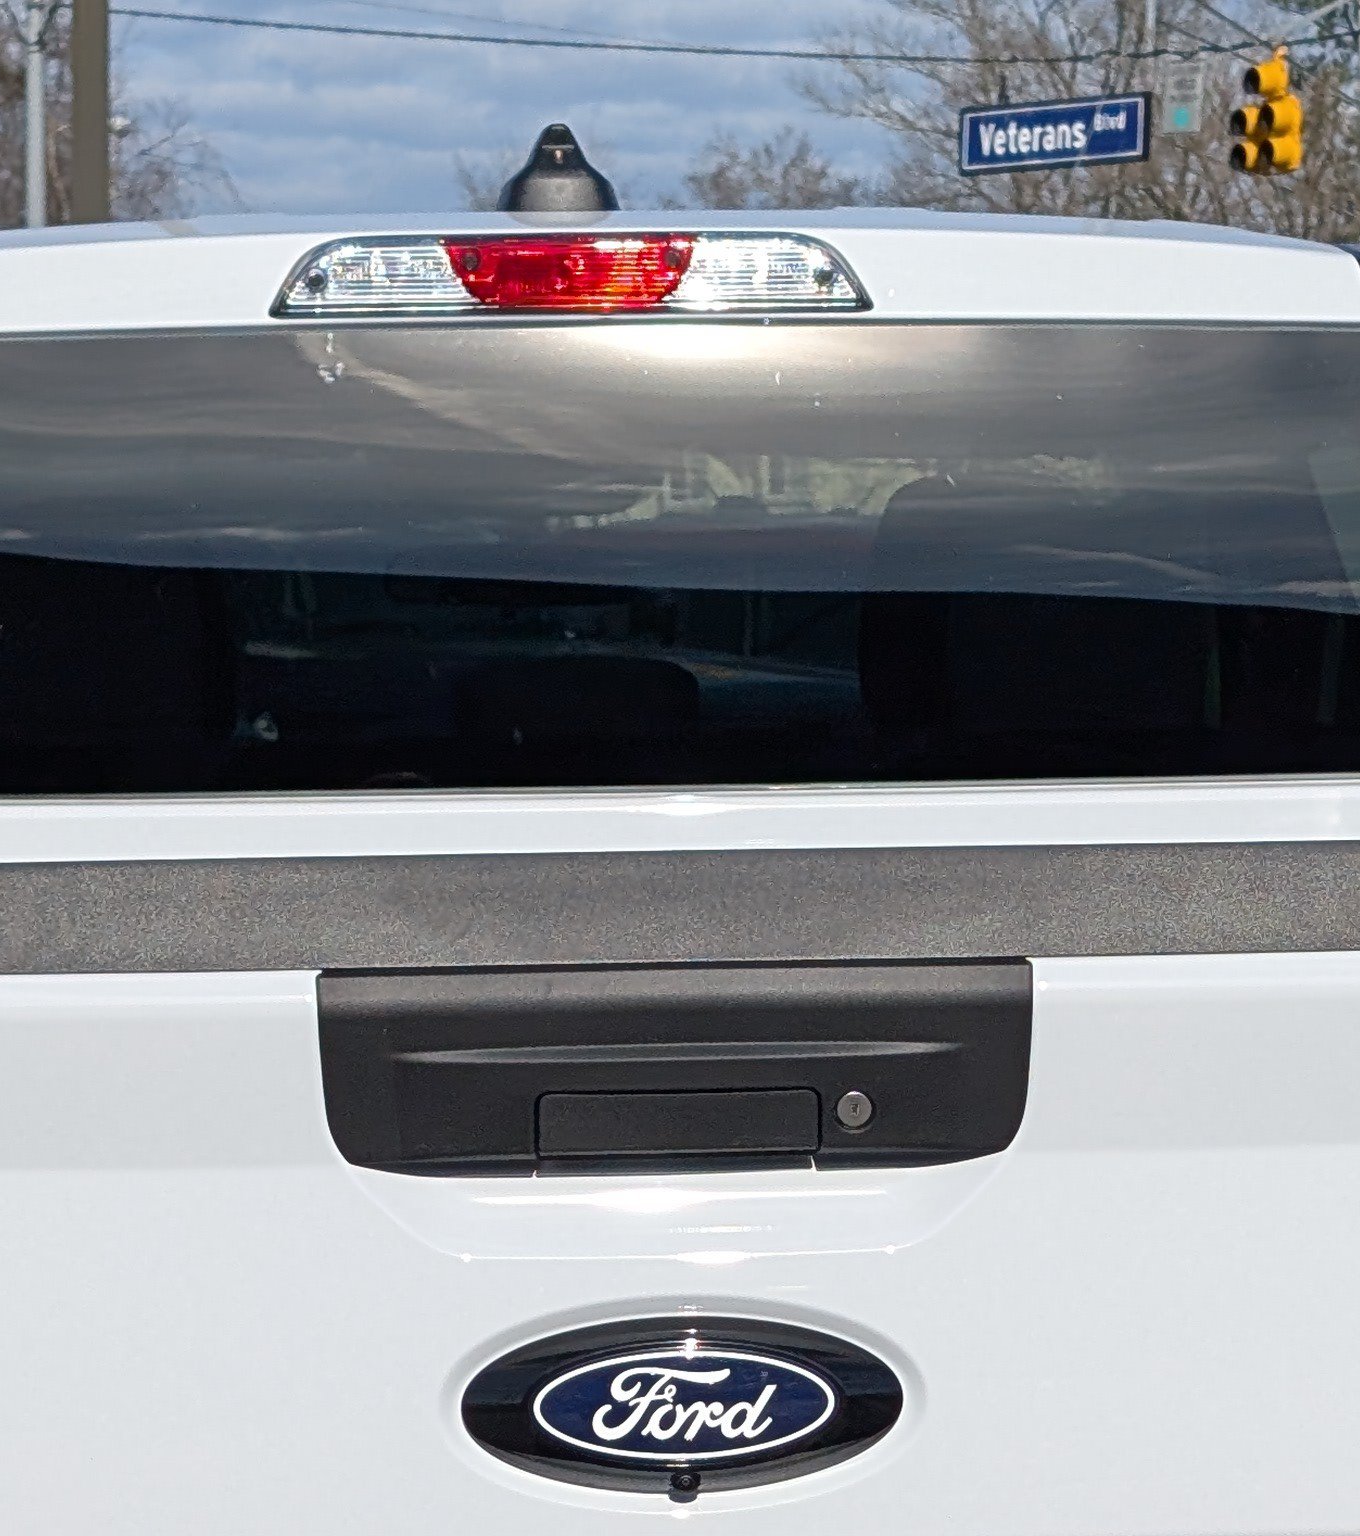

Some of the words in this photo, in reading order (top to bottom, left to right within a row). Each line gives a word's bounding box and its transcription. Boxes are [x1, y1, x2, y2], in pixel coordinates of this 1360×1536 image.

[979, 121, 1088, 156] Veterans
[1093, 110, 1128, 131] Blvd
[591, 1366, 777, 1441] Ford
